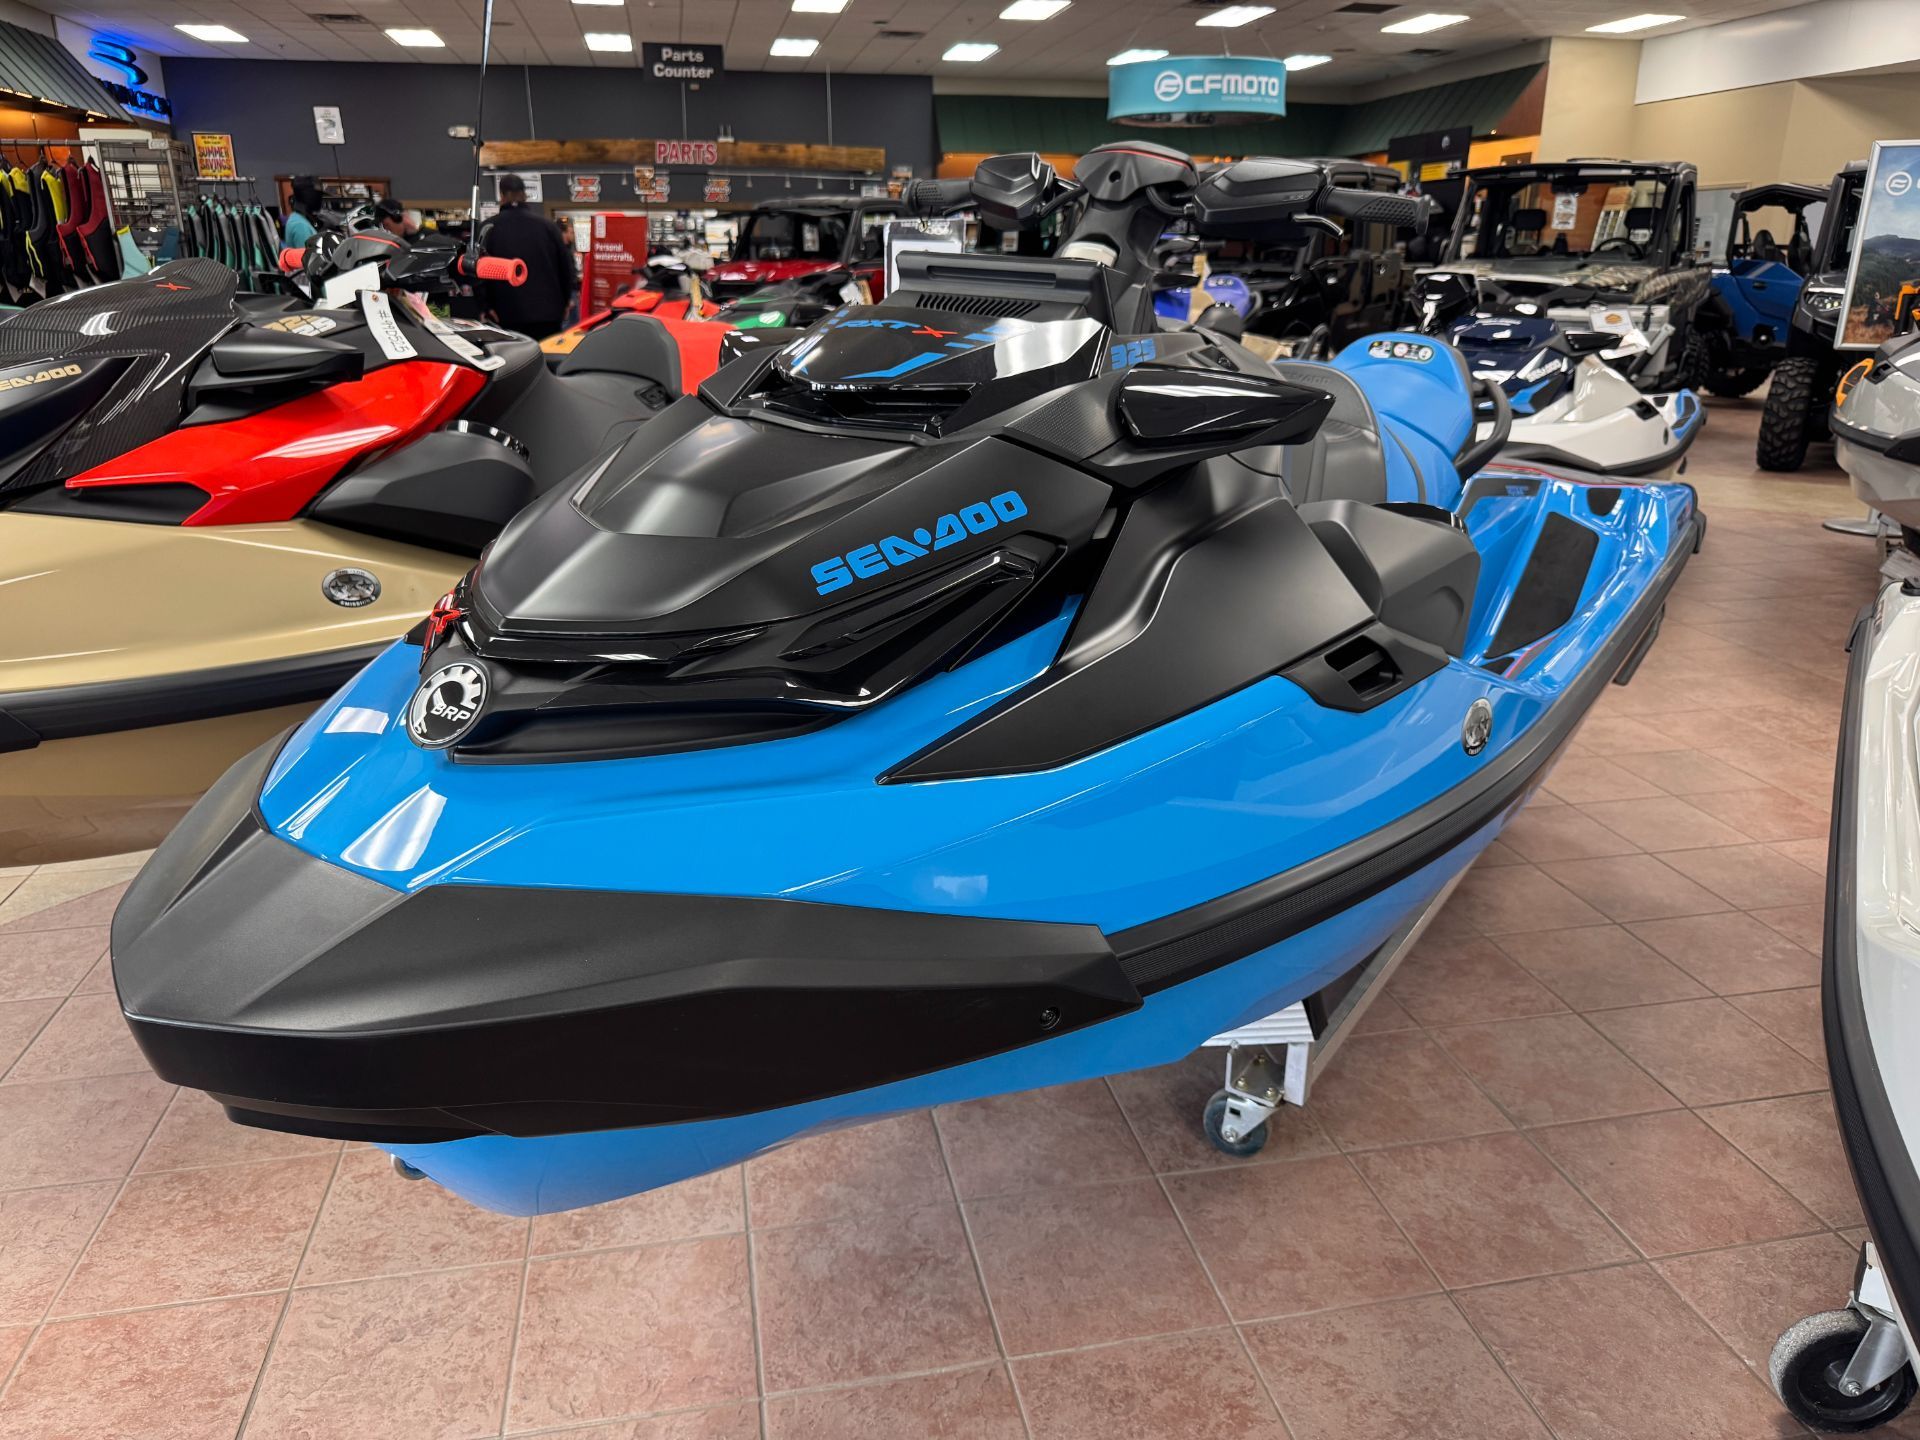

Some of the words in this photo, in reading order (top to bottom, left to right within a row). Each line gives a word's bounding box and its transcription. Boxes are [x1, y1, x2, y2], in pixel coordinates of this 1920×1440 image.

[661, 47, 704, 62] Parts
[653, 63, 714, 79] Counter
[1185, 74, 1279, 97] CFMOTO
[655, 141, 718, 166] PARTS
[1110, 337, 1156, 370] 325
[430, 703, 471, 722] BRP
